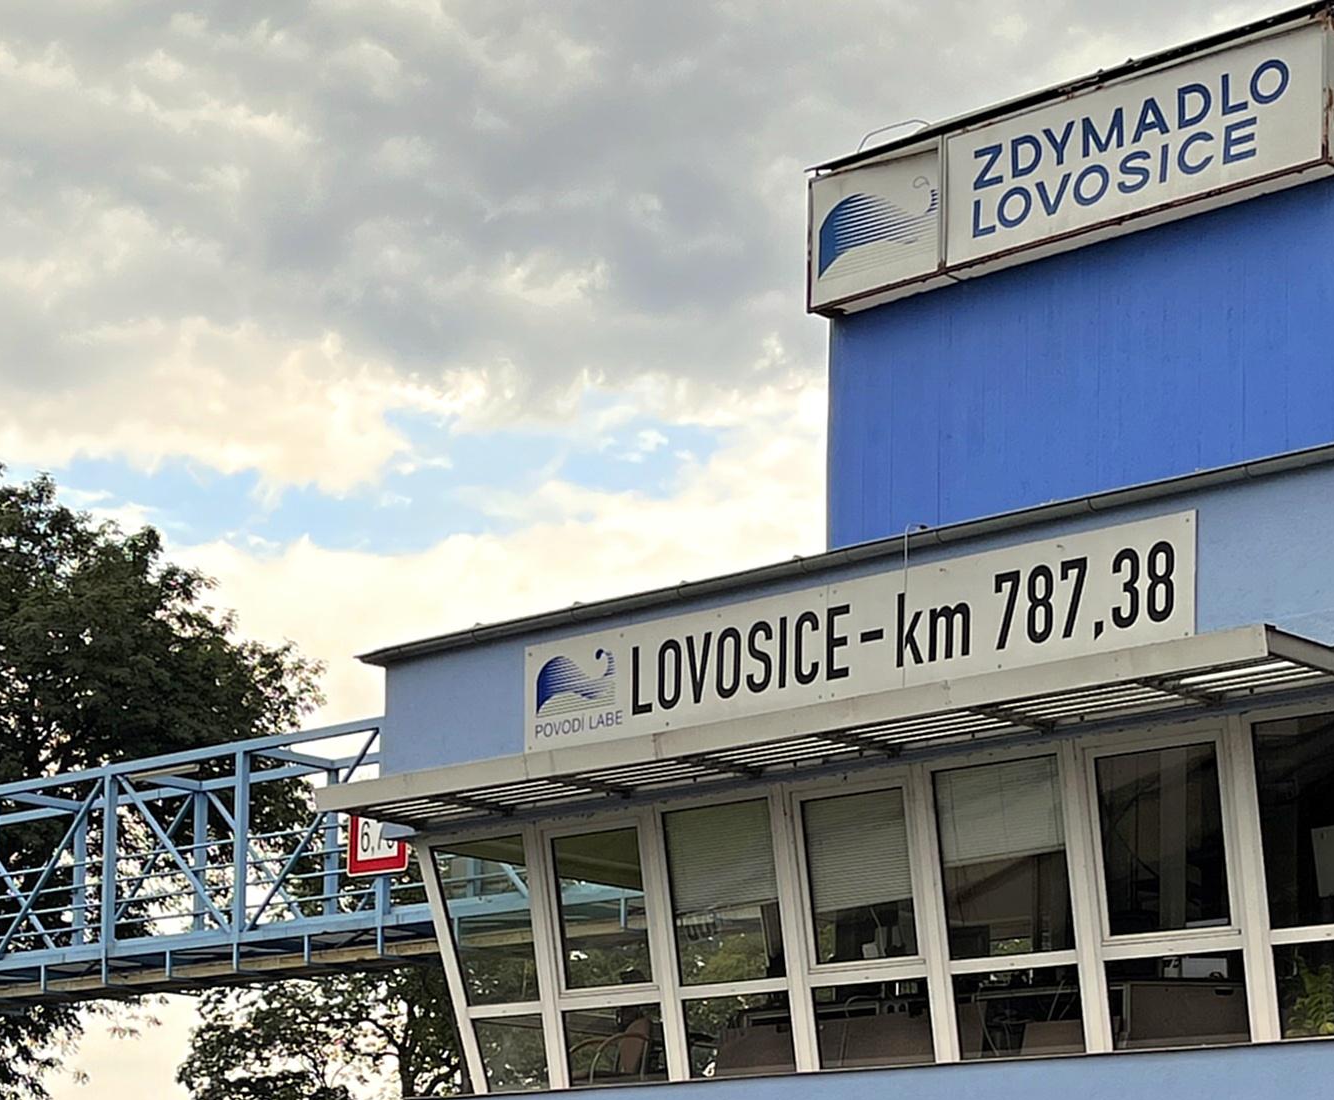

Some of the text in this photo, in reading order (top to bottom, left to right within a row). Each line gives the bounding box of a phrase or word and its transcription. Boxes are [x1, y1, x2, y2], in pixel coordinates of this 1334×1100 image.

[972, 116, 1258, 239] LOVOSICE
[973, 58, 1290, 191] ZDYMADLO
[994, 540, 1175, 651] 787,38
[535, 710, 623, 739] POVODÍ LABE
